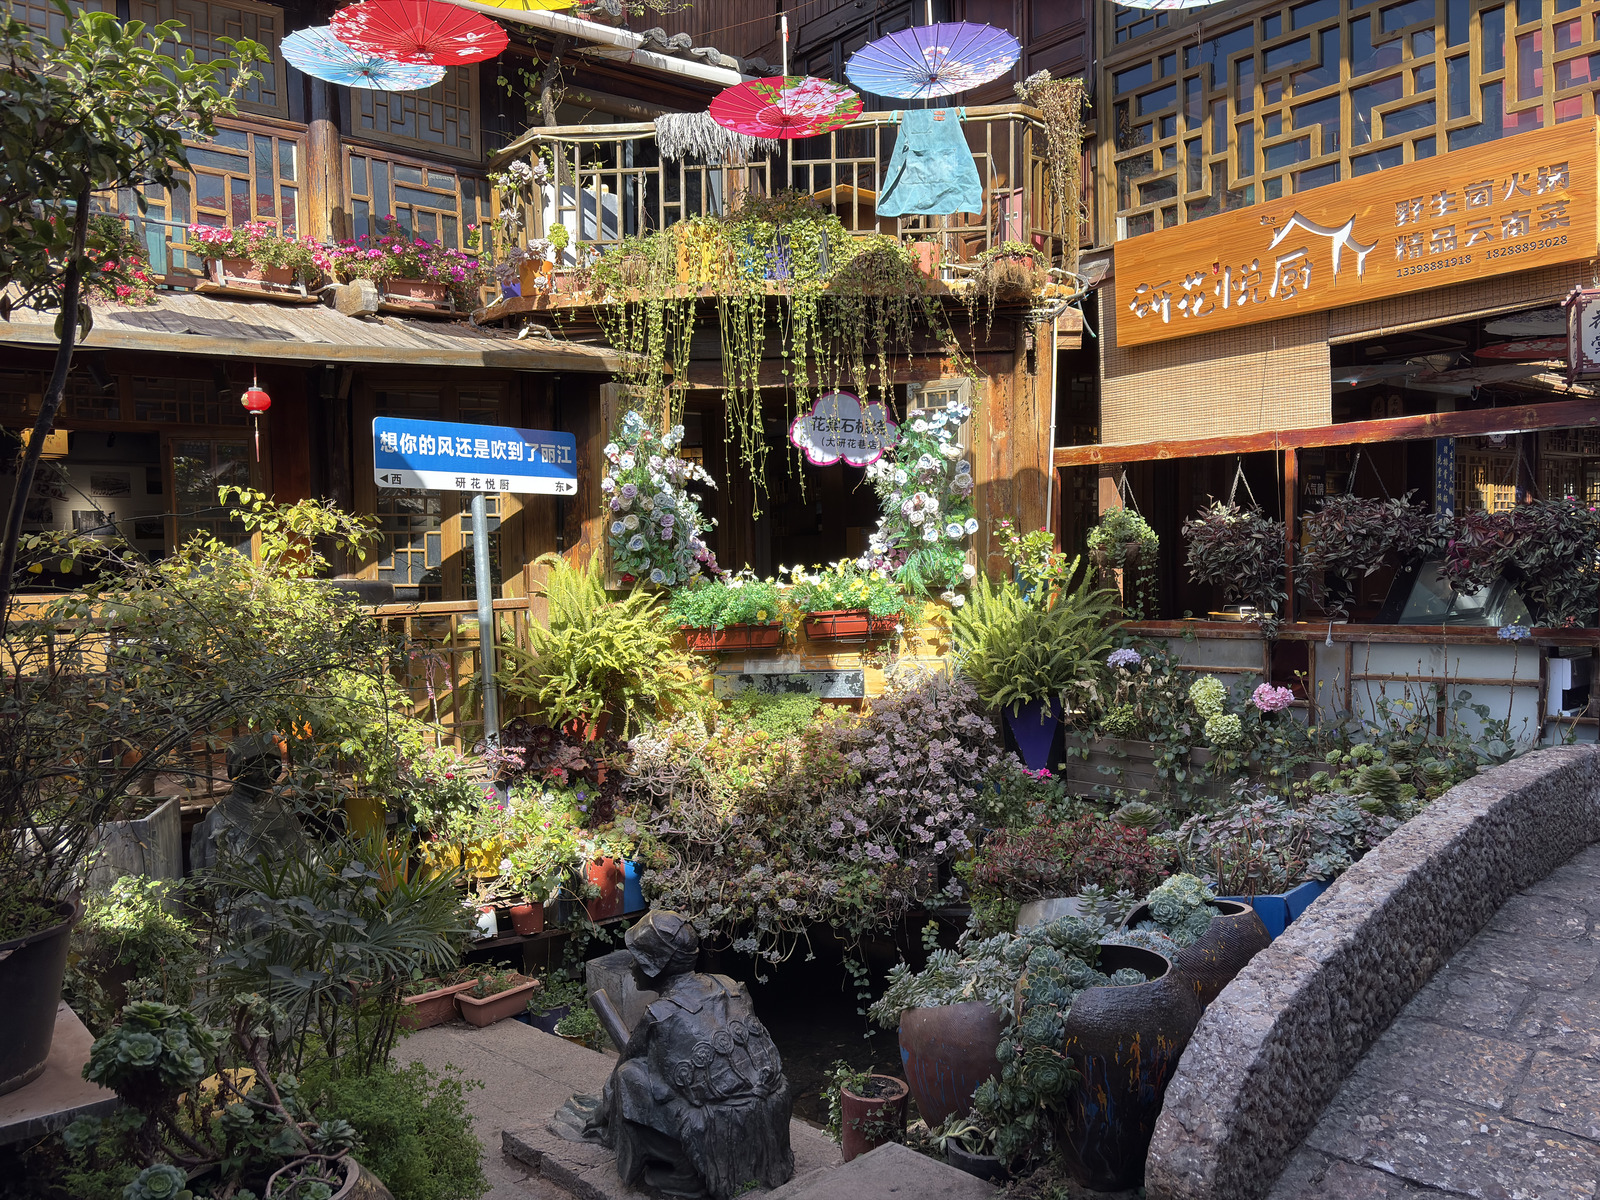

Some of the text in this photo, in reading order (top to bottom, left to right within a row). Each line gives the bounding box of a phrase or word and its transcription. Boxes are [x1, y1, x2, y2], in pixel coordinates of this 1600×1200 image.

[1395, 161, 1570, 227] 野生菌火锅
[1394, 199, 1571, 262] 精品云南菜
[1396, 235, 1568, 278] 13398881918 18288893028
[1128, 246, 1314, 324] 研花悦厨
[379, 431, 572, 464] 想你的风还是吹到了丽江
[391, 473, 565, 492] 西 研花悦厨 东
